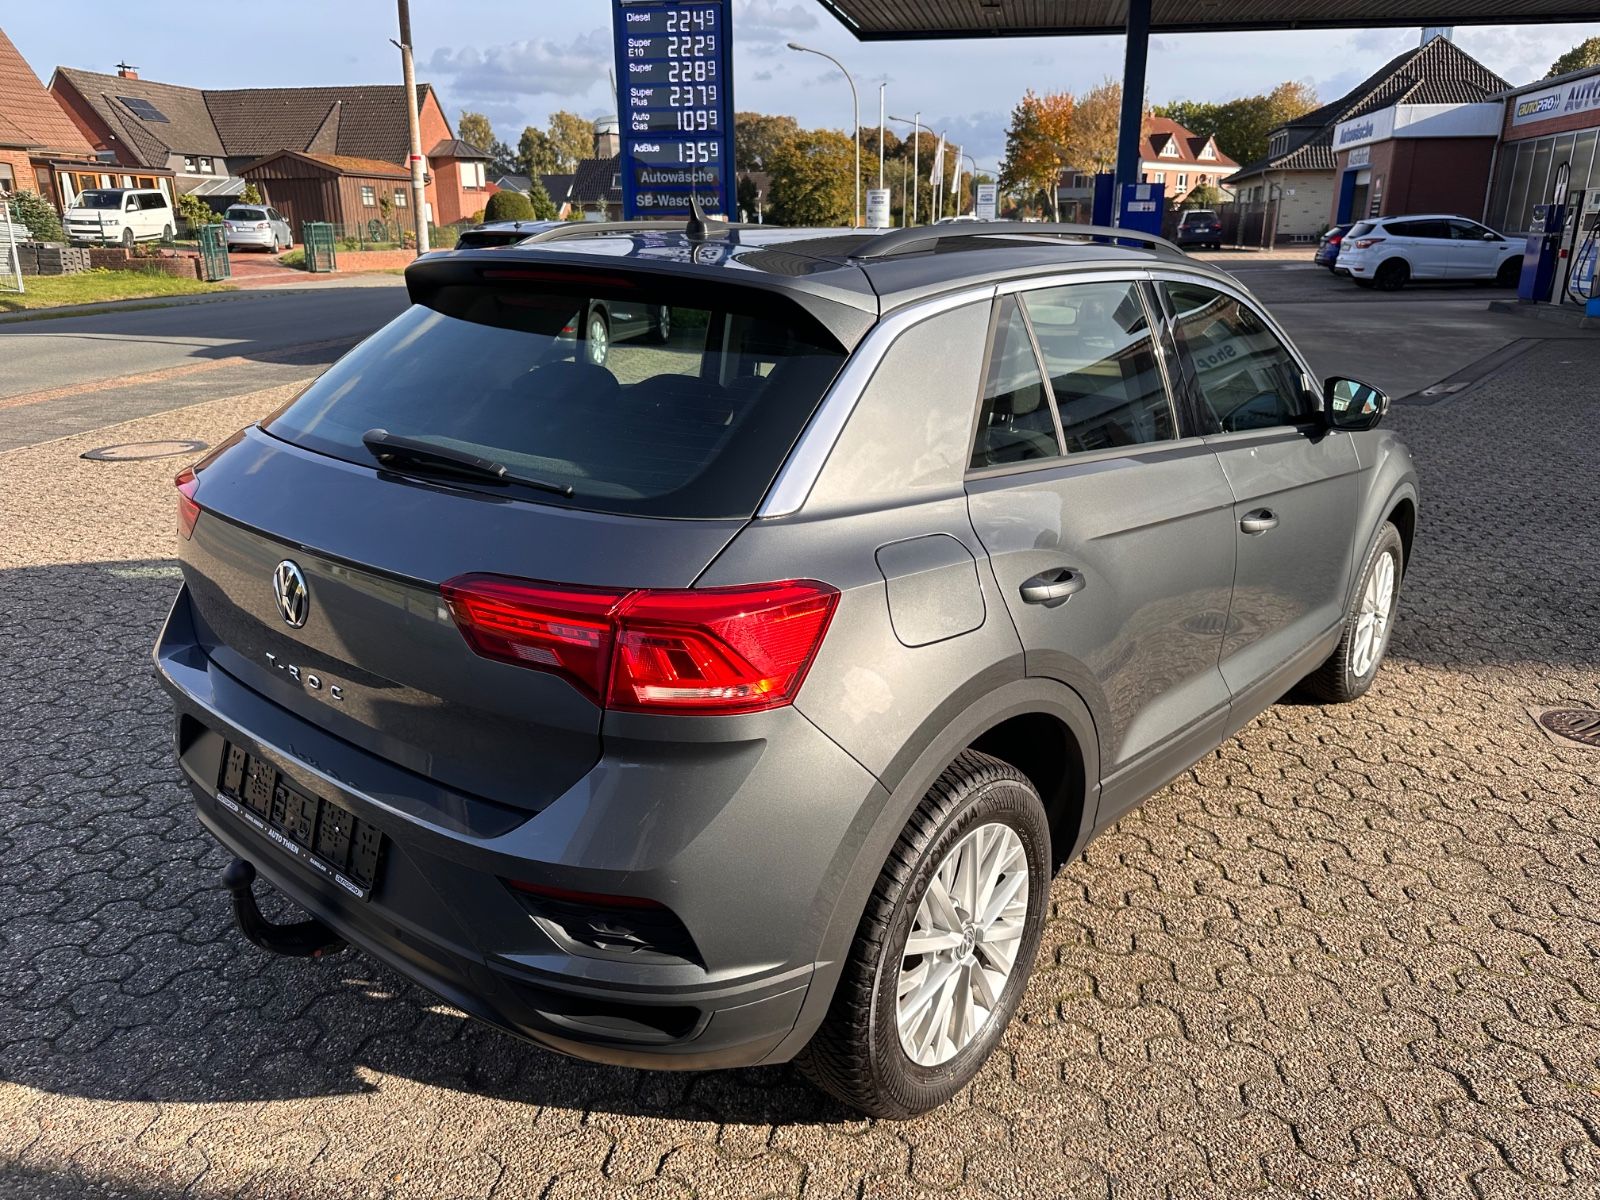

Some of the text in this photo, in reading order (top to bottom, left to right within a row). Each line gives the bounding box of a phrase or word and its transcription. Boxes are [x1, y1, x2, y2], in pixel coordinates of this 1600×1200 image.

[626, 13, 651, 22] Diesel
[666, 10, 715, 33] 2249
[628, 39, 651, 48] Super
[667, 35, 716, 58] 2229
[628, 48, 644, 57] E10
[629, 63, 652, 73] Super
[668, 61, 716, 83] 2289
[630, 88, 653, 98] Super
[669, 85, 717, 107] 2379
[631, 98, 648, 107] Plus
[632, 112, 649, 121] Auto
[677, 110, 718, 131] 1099
[632, 122, 648, 131] Gas
[633, 143, 660, 152] AdBlue
[678, 142, 719, 163] 1359
[641, 171, 713, 182] Autowäsche
[636, 194, 720, 208] SB-Wascbox
[265, 651, 344, 702] T-ROC
[268, 828, 283, 842] AUTO
[282, 836, 300, 855] THIEN
[906, 804, 979, 905] YOKOHAMA
